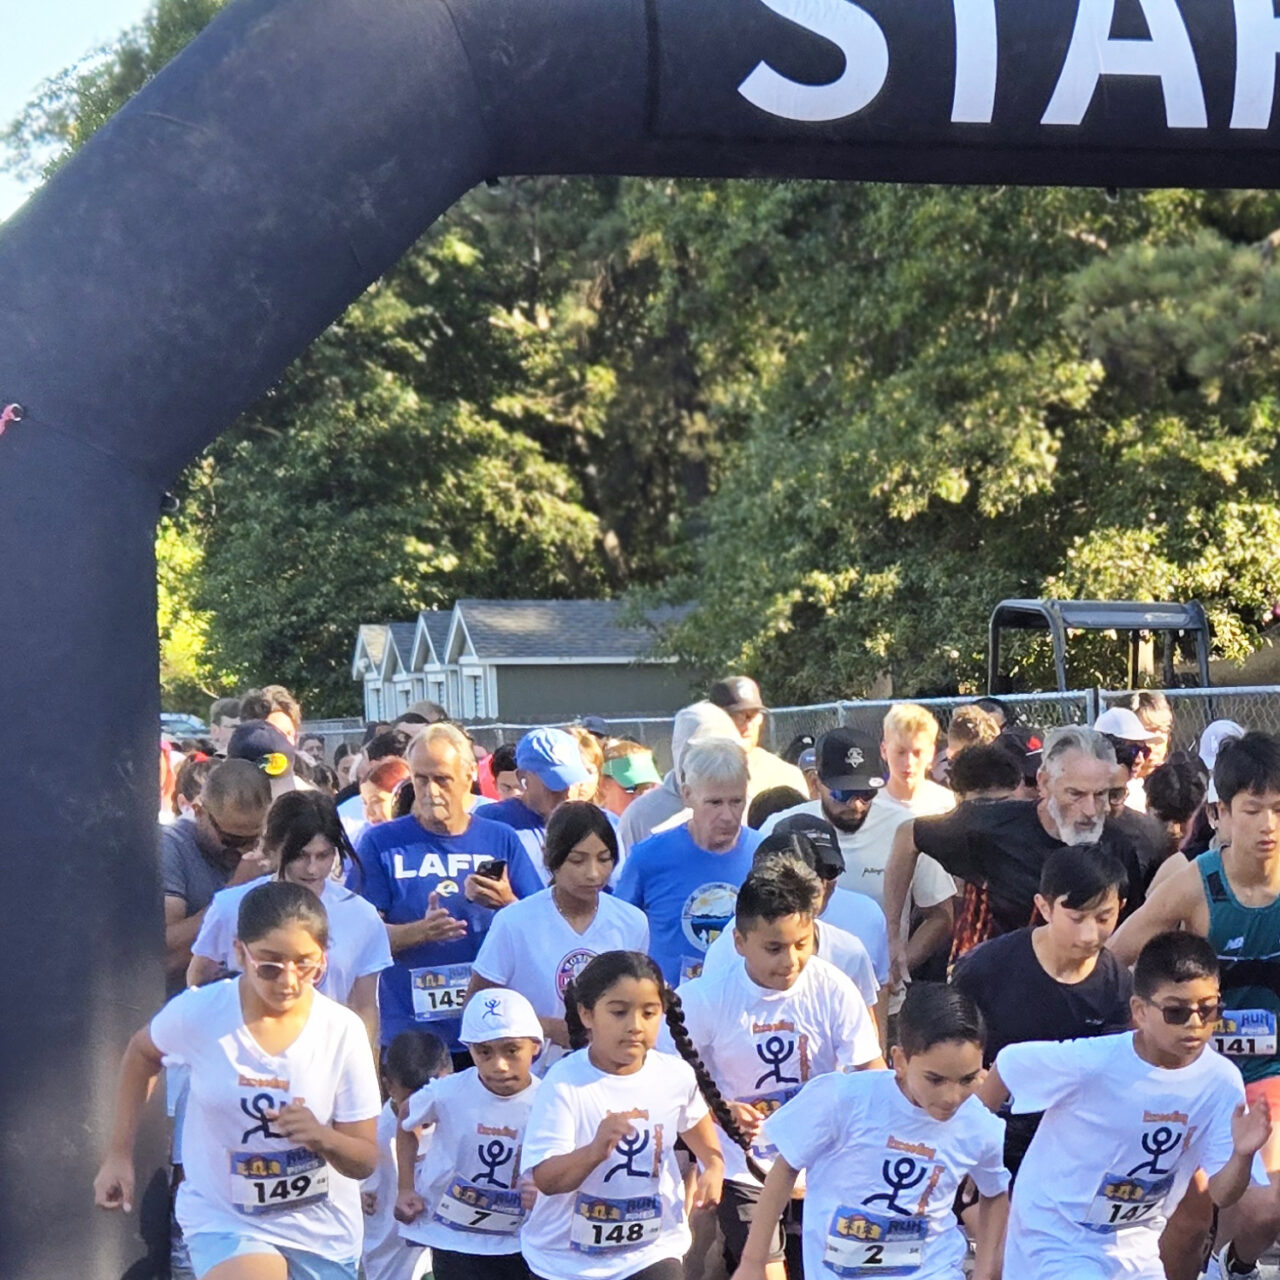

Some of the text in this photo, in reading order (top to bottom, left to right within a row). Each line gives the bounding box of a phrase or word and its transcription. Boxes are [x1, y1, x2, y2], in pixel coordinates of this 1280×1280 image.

[428, 989, 468, 1010] 145
[1214, 1038, 1256, 1053] 141
[254, 1175, 311, 1203] 149
[469, 1210, 492, 1226] 7
[1109, 1201, 1158, 1223] 147
[592, 1223, 644, 1244] 148
[862, 1245, 884, 1264] 2
